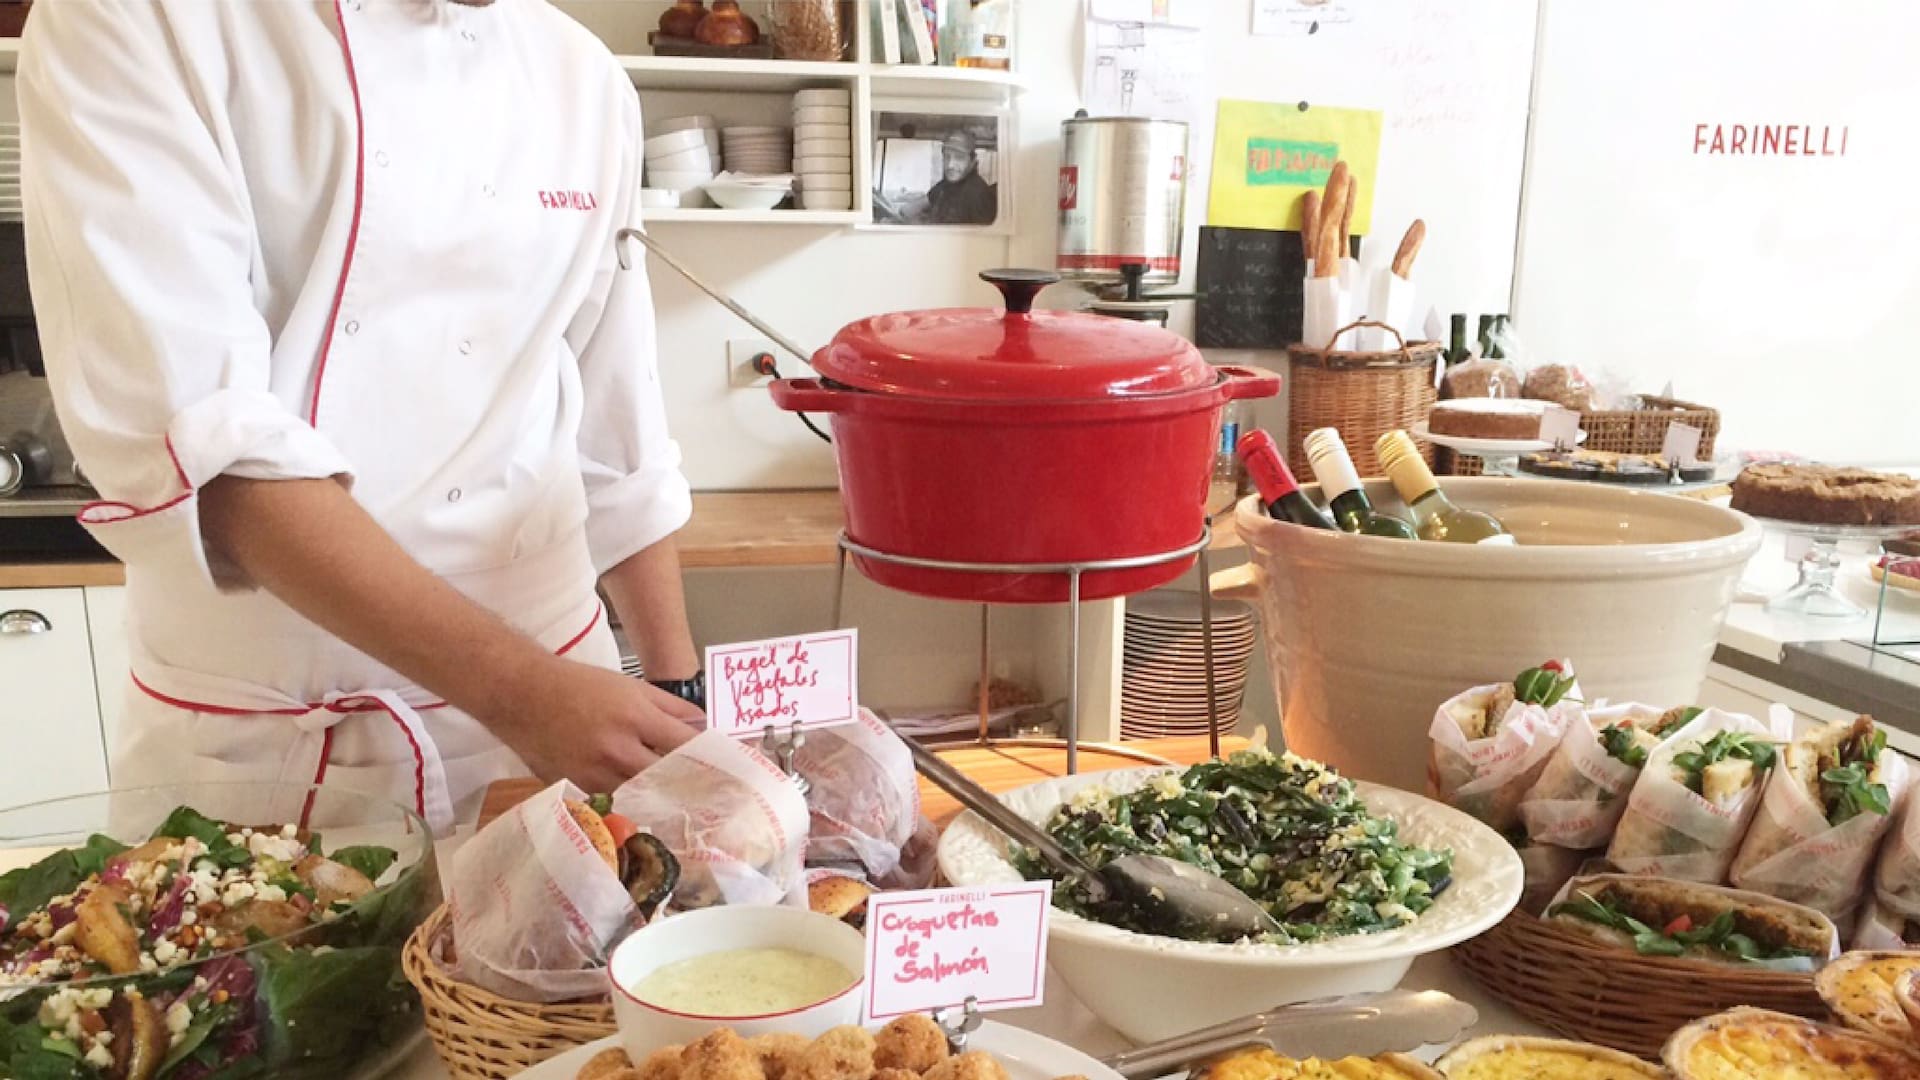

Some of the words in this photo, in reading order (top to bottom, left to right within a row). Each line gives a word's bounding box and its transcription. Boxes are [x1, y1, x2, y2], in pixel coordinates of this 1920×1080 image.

[1693, 123, 1848, 156] FARINELLI
[724, 646, 776, 682] Bagel
[787, 640, 809, 664] de
[881, 904, 999, 939] Croquetas
[894, 935, 920, 957] de
